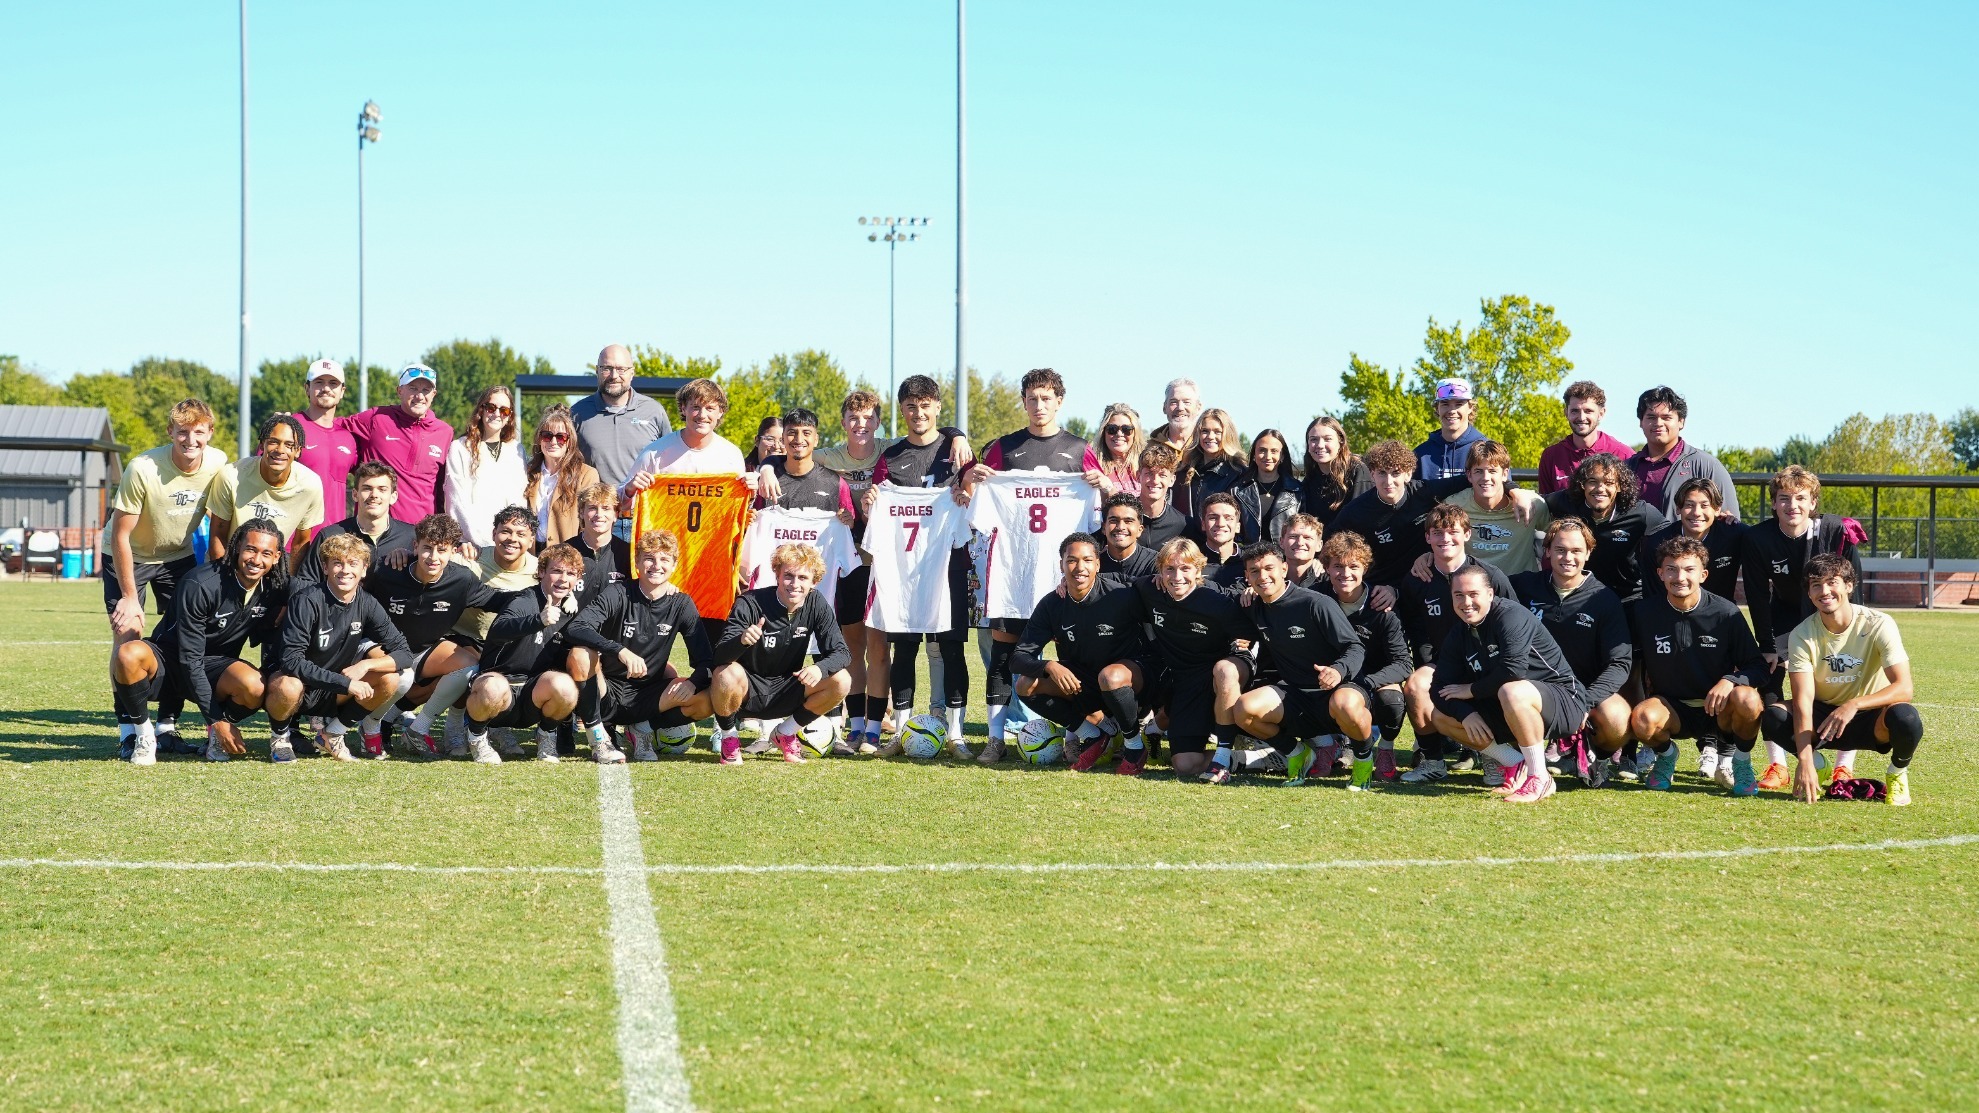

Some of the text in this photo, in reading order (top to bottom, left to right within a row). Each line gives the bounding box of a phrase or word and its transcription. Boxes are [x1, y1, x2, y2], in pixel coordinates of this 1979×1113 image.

[667, 484, 724, 498] EAGLES
[849, 481, 874, 491] SOCC
[1015, 487, 1060, 499] EAGLES
[687, 501, 702, 533] 0
[889, 505, 933, 517] EAGLES
[1028, 503, 1048, 534] 8
[774, 528, 818, 541] EAGLES
[902, 522, 920, 552] 7
[1377, 532, 1393, 544] 32
[1472, 541, 1509, 551] SOCCER
[1773, 564, 1789, 575] 34
[389, 602, 405, 615] 35
[1427, 604, 1441, 616] 20
[1153, 614, 1165, 628] 12
[622, 625, 636, 638] 15
[1067, 630, 1076, 642] 6
[319, 634, 330, 648] 17
[764, 635, 777, 648] 19
[1656, 641, 1672, 654] 26
[1468, 659, 1482, 673] 14
